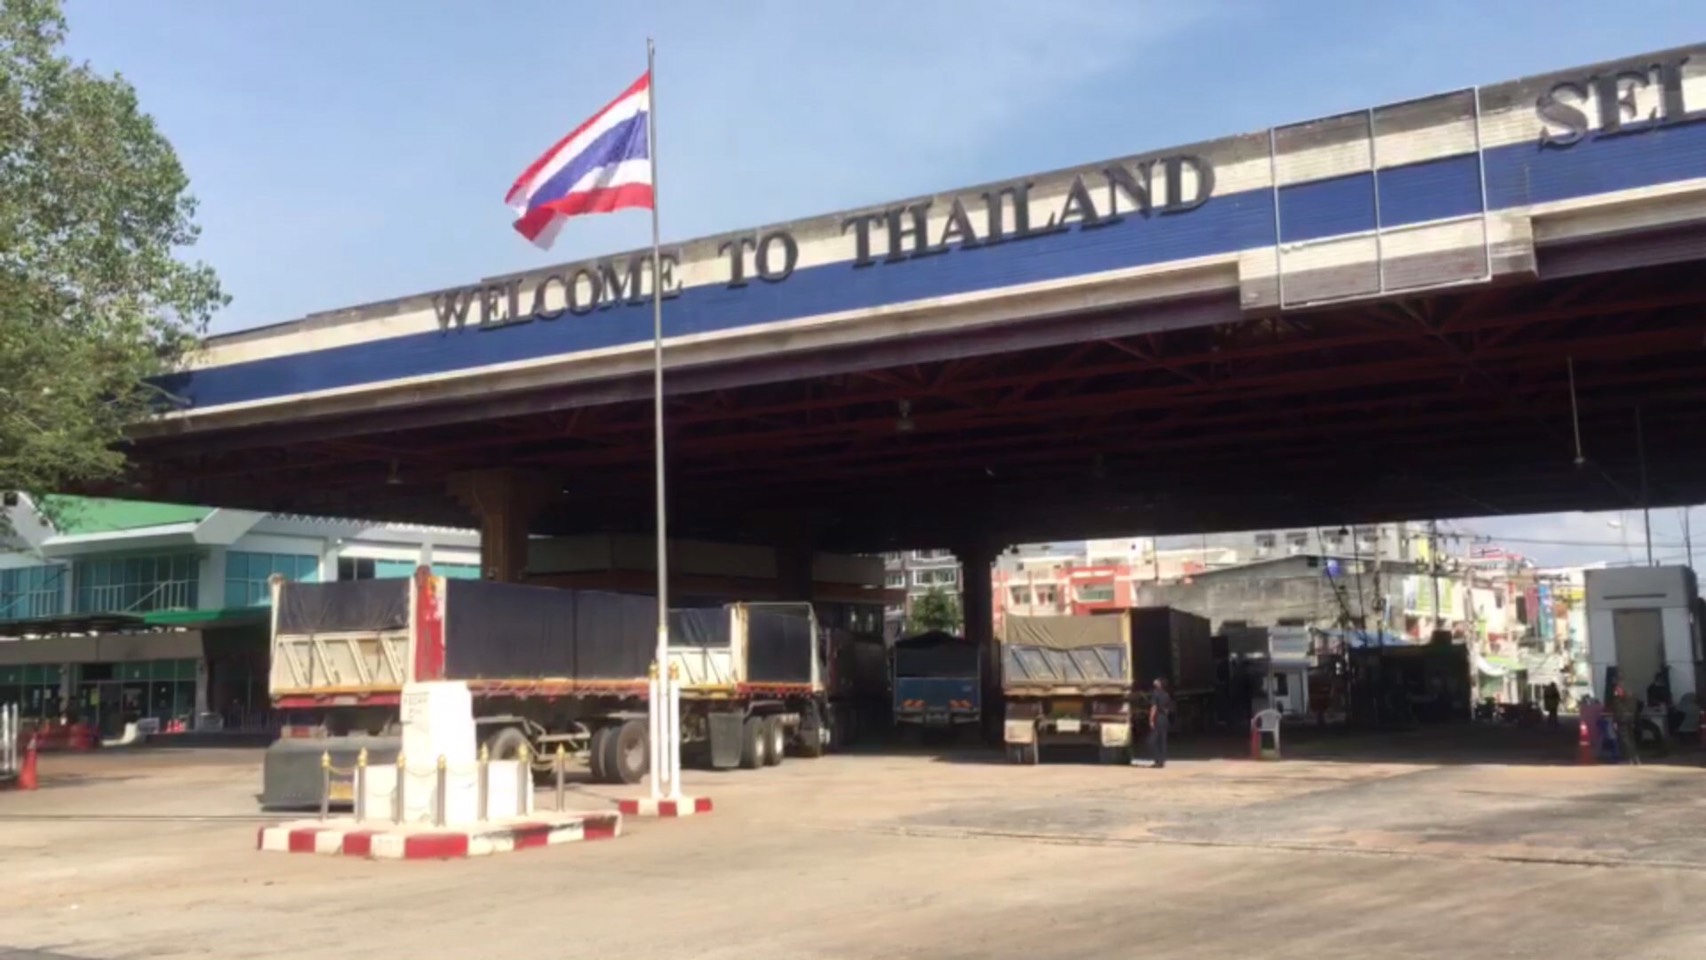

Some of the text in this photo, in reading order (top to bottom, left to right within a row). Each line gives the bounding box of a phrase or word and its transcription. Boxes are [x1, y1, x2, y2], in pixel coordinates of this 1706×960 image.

[431, 153, 1216, 337] WELCOME TO THAILAND
